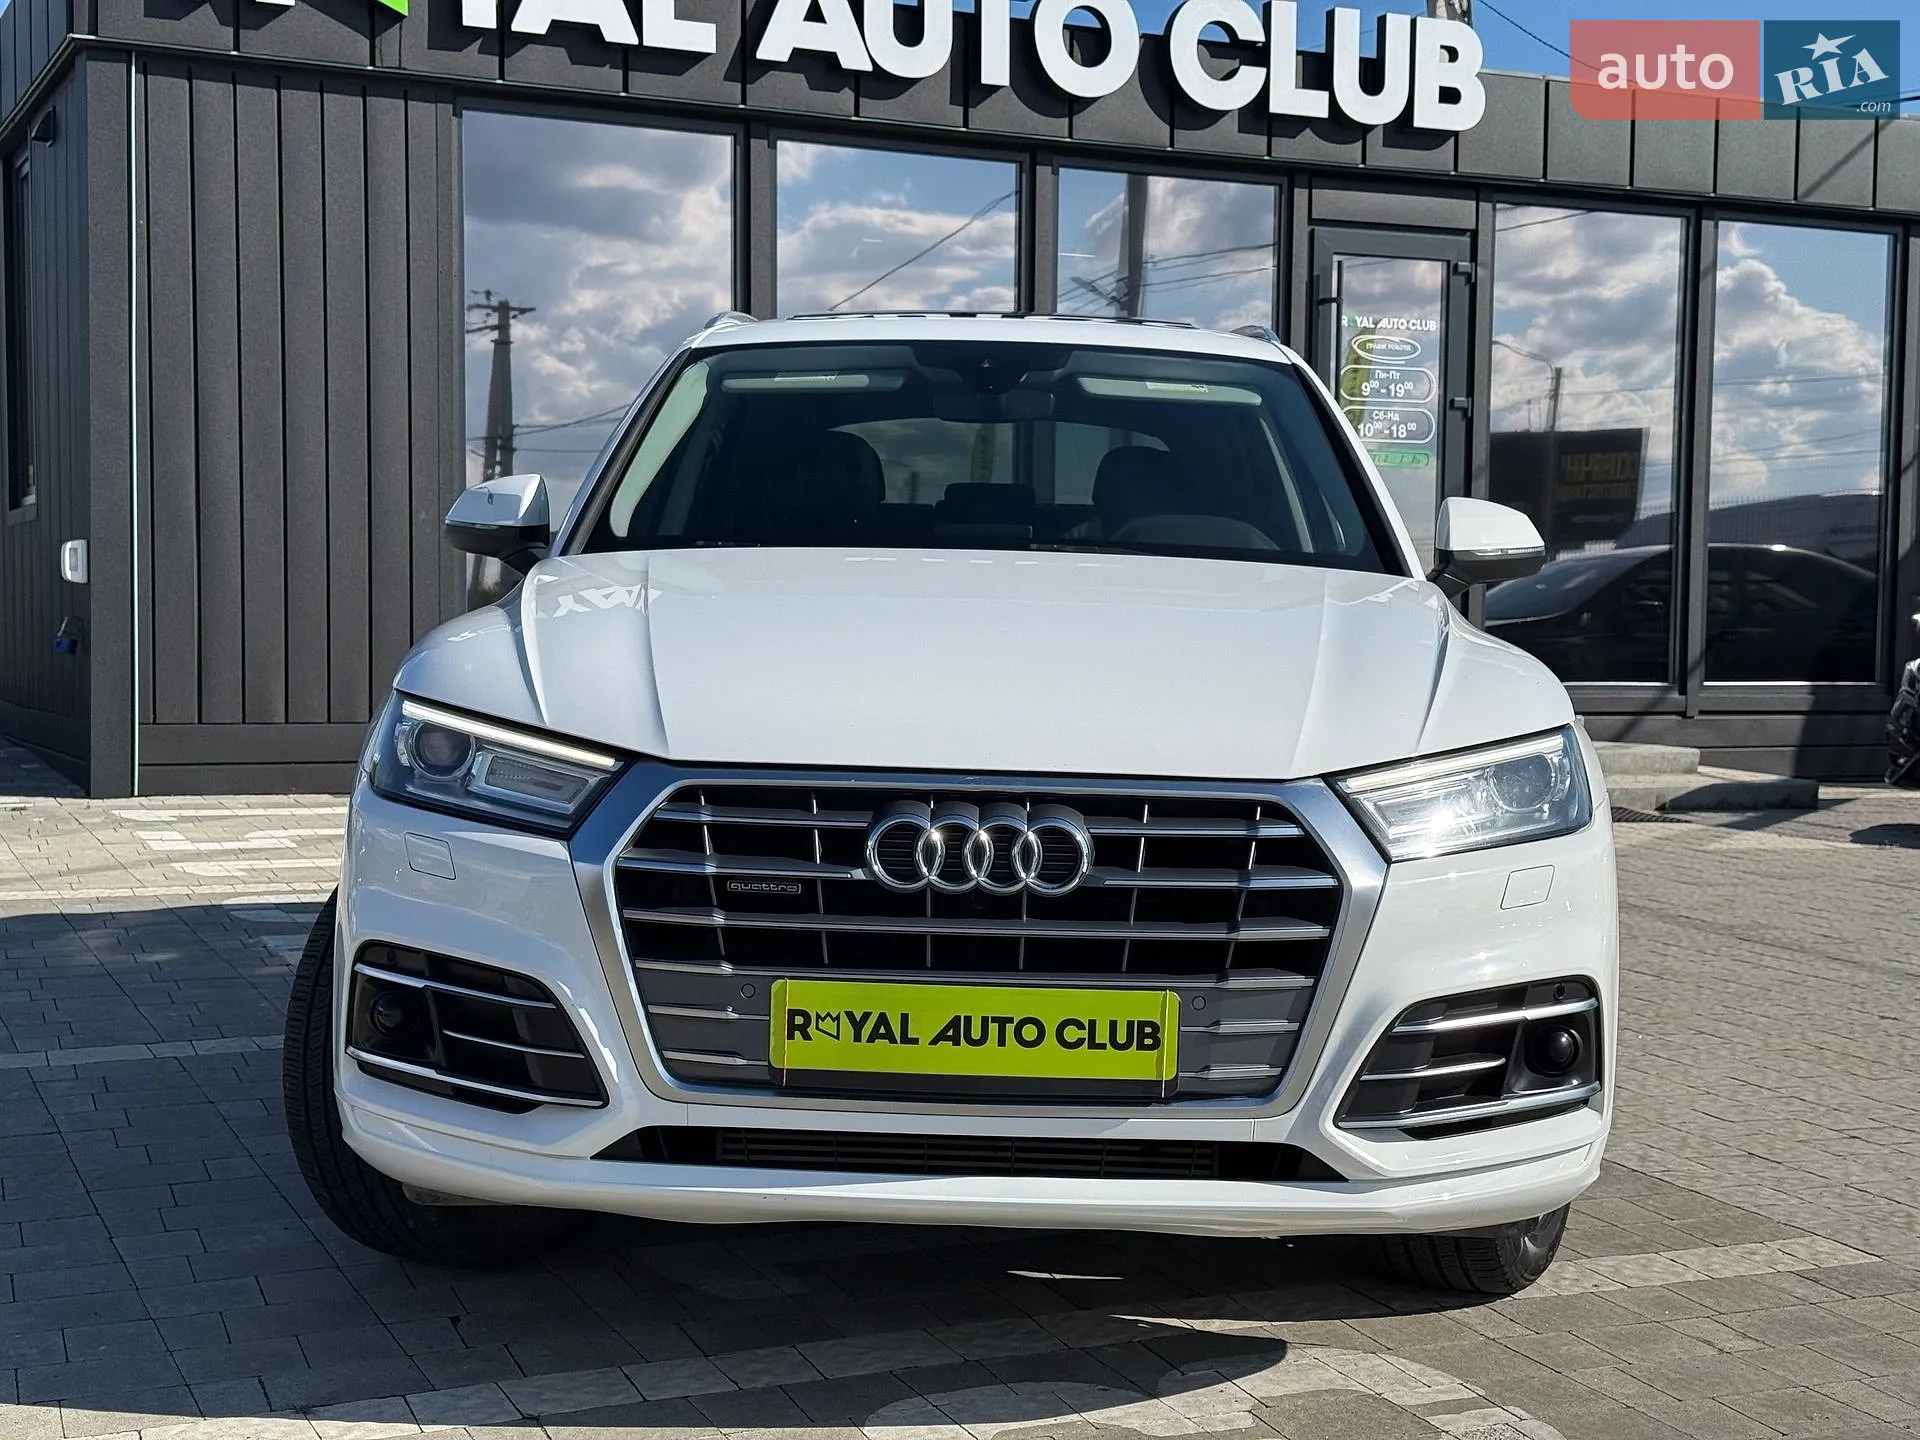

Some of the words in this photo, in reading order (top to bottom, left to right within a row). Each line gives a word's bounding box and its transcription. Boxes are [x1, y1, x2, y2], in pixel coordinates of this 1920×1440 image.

[1169, 0, 1486, 131] CLUB
[1376, 317, 1408, 330] AUTO
[1408, 319, 1436, 332] CLUB
[730, 883, 798, 892] quattro
[928, 1013, 1046, 1049] AUTO
[1054, 1017, 1162, 1052] CLUB
